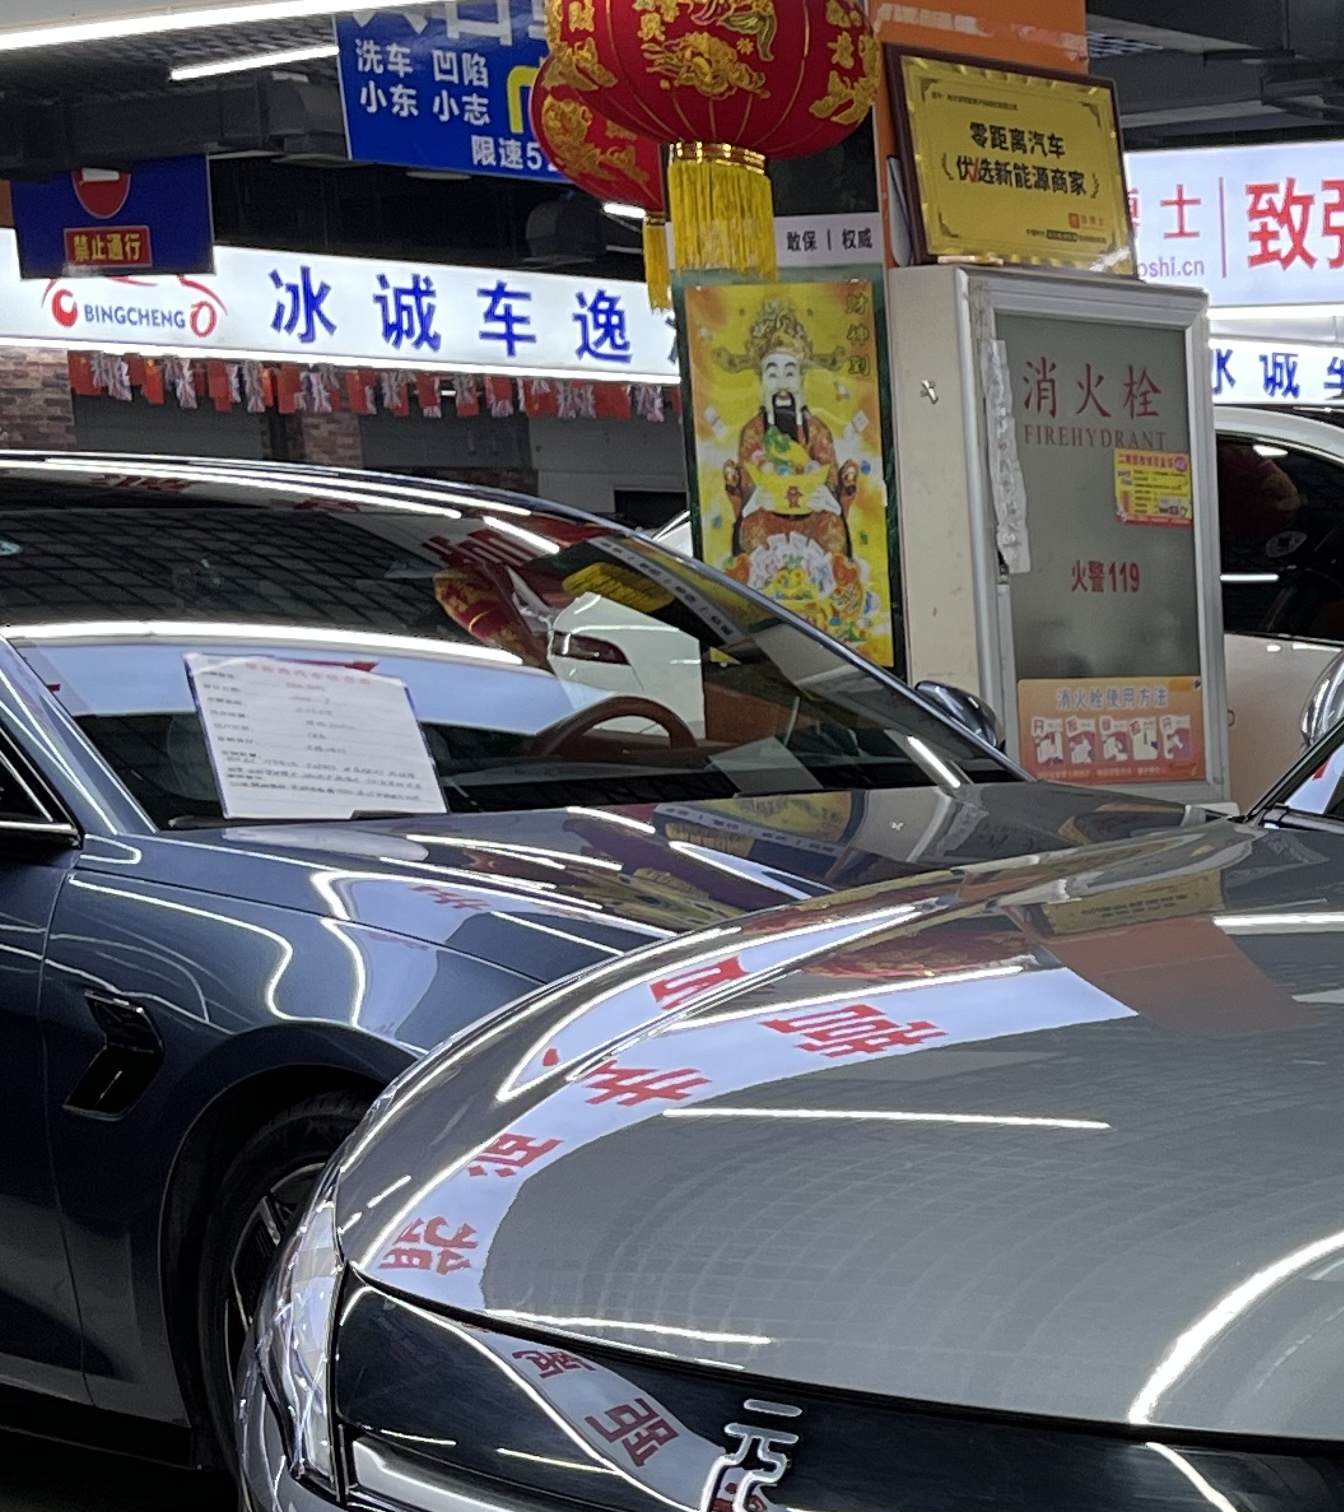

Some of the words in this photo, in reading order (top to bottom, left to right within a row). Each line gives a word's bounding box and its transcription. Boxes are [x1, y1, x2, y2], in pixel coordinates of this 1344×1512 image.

[355, 39, 413, 78] 洗车
[432, 49, 489, 88] 凹陷
[360, 80, 419, 118] 小东
[433, 89, 491, 126] 小志
[470, 134, 558, 173] 限速5
[969, 121, 1066, 159] 零距离汽车
[73, 233, 141, 262] 禁止通行
[84, 304, 186, 329] BINGCHENG
[270, 266, 681, 364] 冰诚车逸
[1022, 356, 1162, 419] 消火栓
[1071, 560, 1141, 593] 火警119
[1056, 685, 1169, 711] 消火栓使用方法
